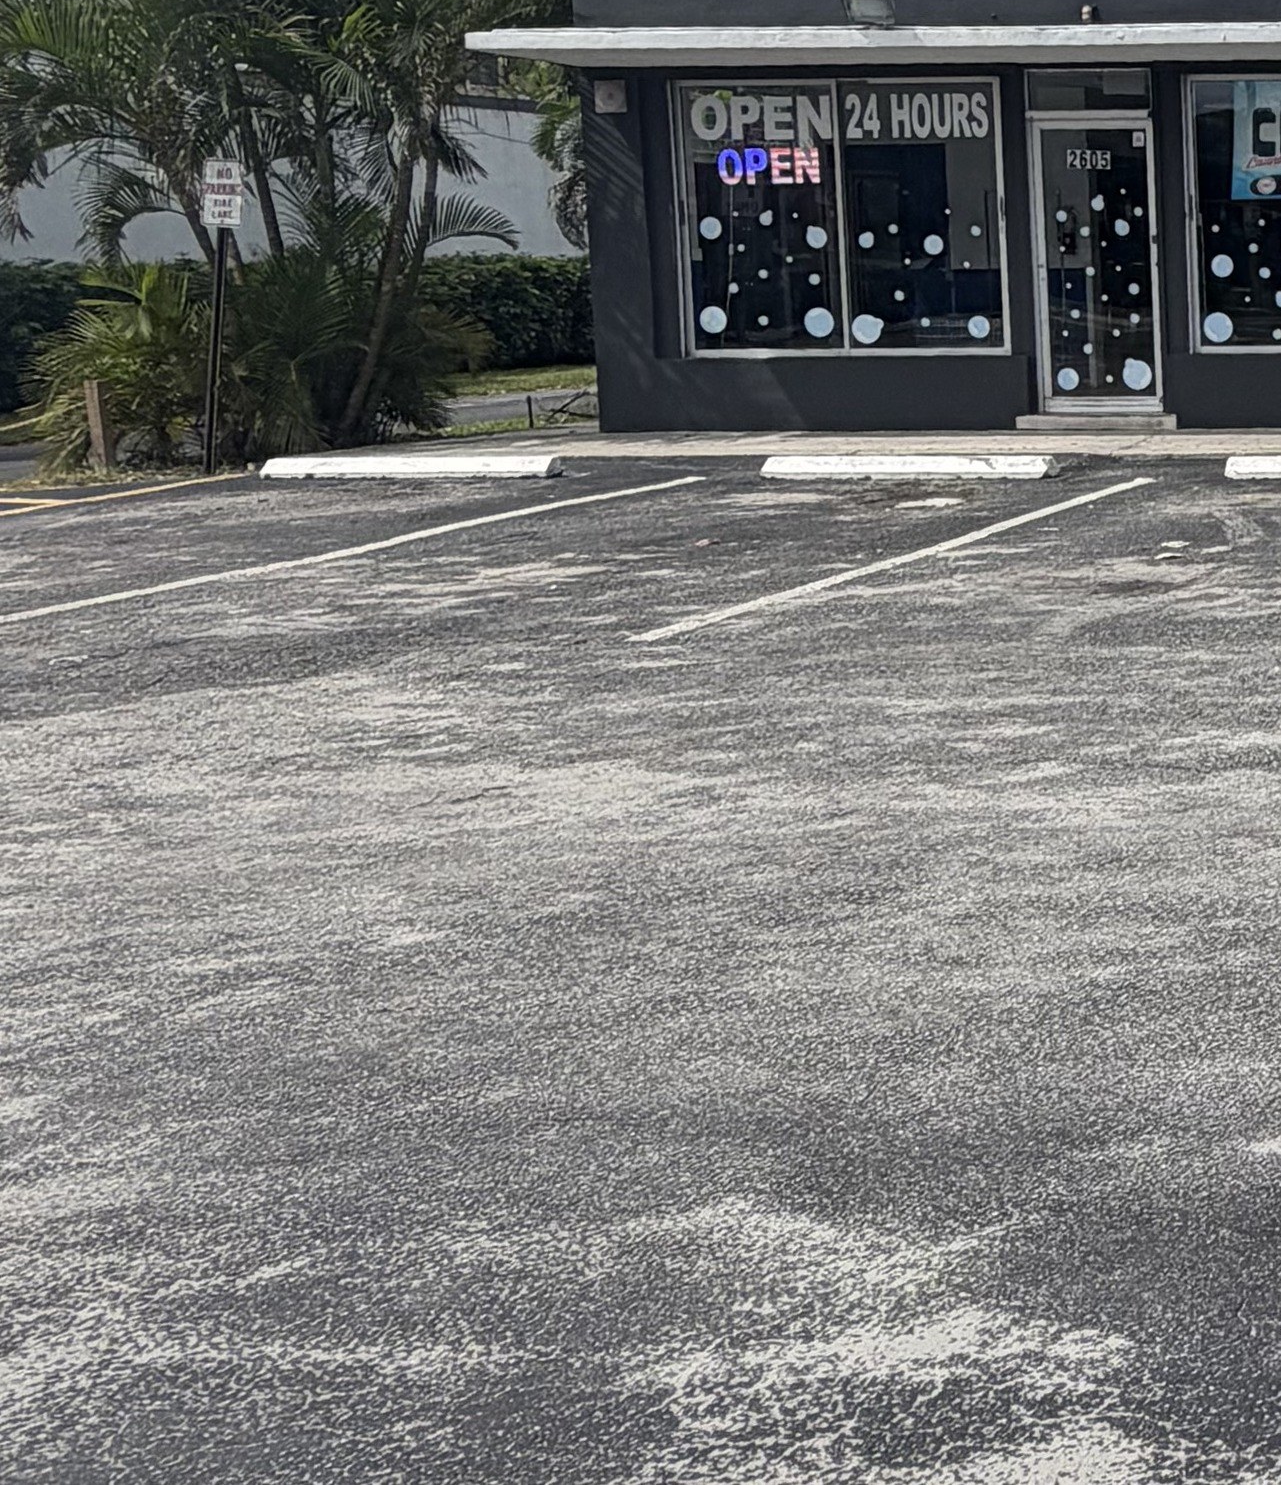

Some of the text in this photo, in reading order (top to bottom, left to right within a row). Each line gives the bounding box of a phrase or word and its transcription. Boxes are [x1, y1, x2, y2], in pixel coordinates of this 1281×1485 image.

[690, 92, 989, 141] OPEN 24 HOURS
[217, 167, 232, 180] NO
[717, 147, 821, 185] OPEN
[1067, 150, 1111, 169] 2605
